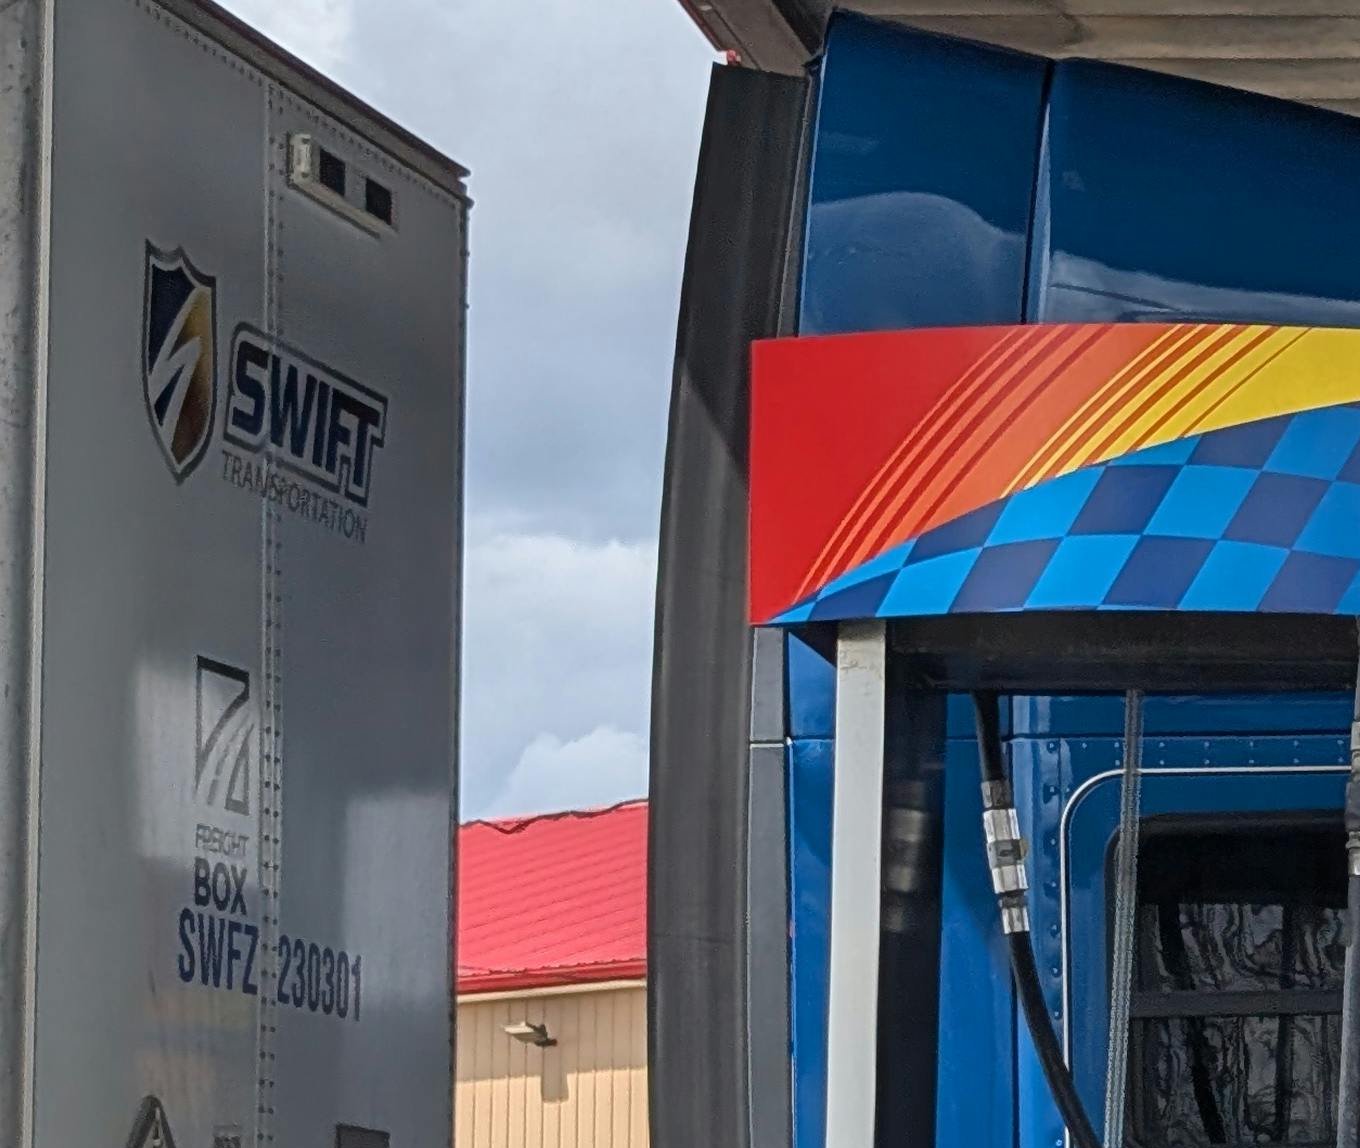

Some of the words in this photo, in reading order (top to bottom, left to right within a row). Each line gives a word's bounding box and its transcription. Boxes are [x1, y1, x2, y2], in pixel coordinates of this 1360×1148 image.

[231, 341, 381, 488] SWIFT
[221, 450, 368, 544] TRANSPORTATION
[193, 856, 248, 916] BOX
[178, 907, 259, 996] SWFZ
[277, 934, 362, 1022] 230301
